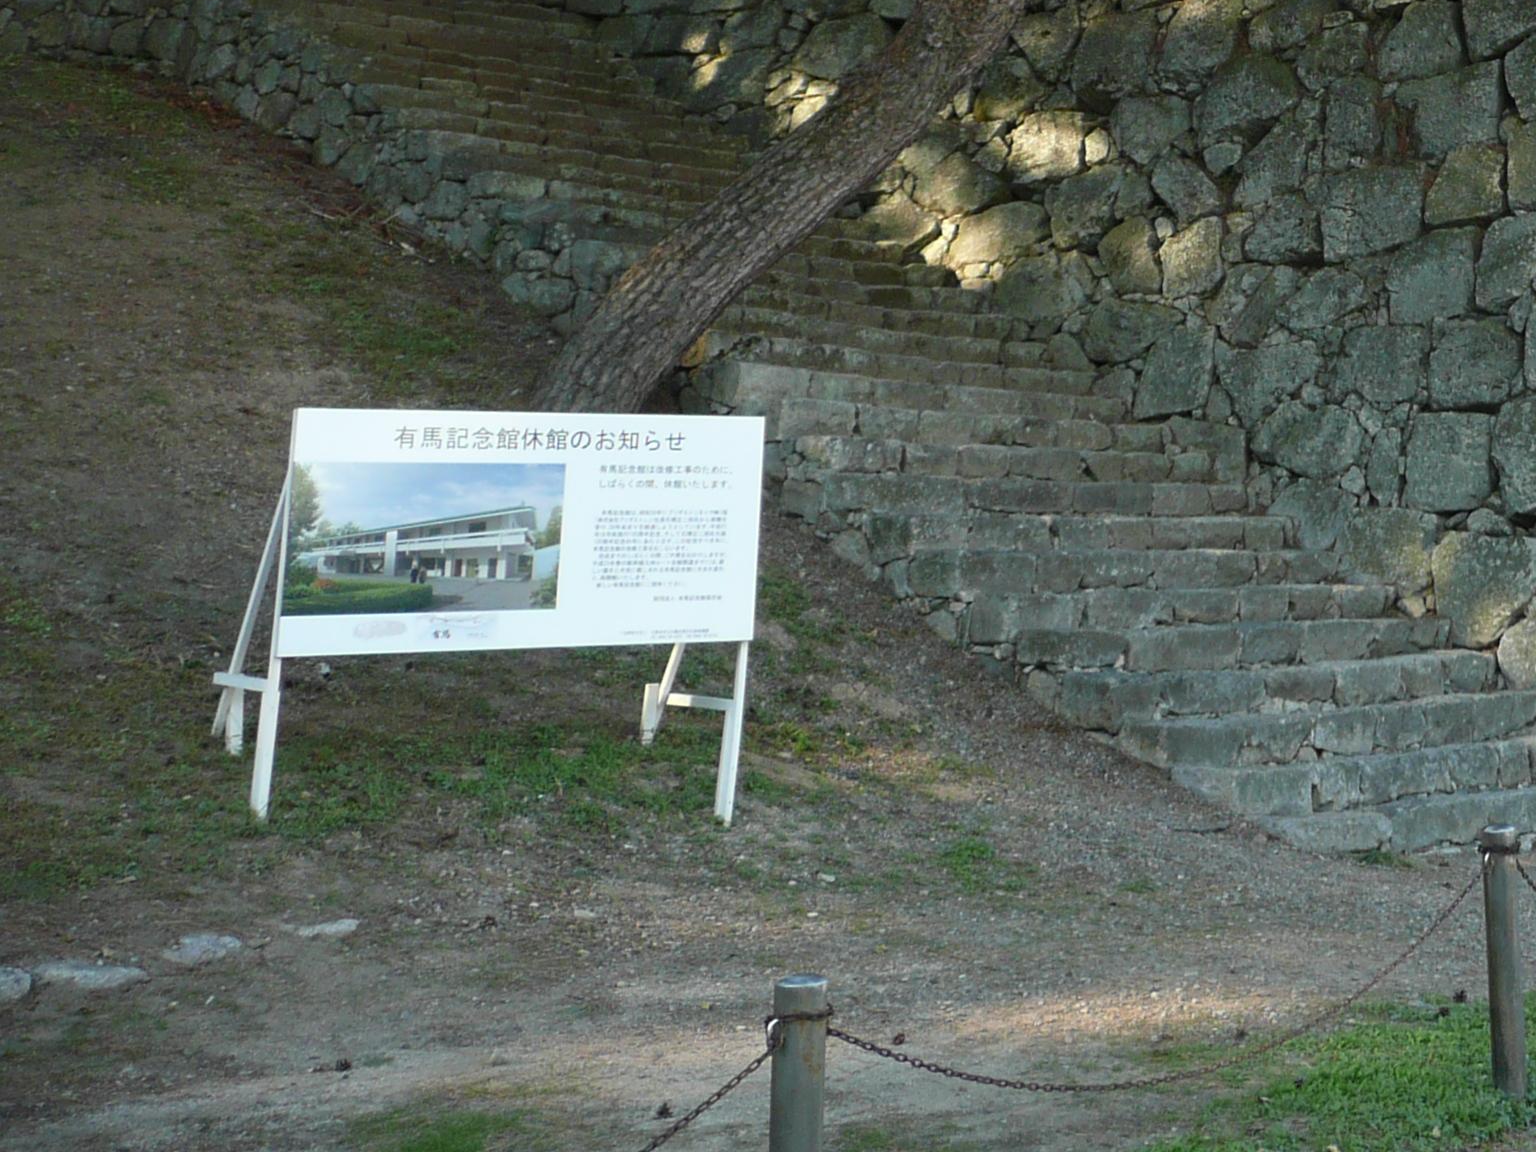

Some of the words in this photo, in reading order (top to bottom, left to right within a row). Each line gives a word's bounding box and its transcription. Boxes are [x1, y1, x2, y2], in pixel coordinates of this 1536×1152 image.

[394, 426, 686, 452] 有馬記念館休館のお知らせ
